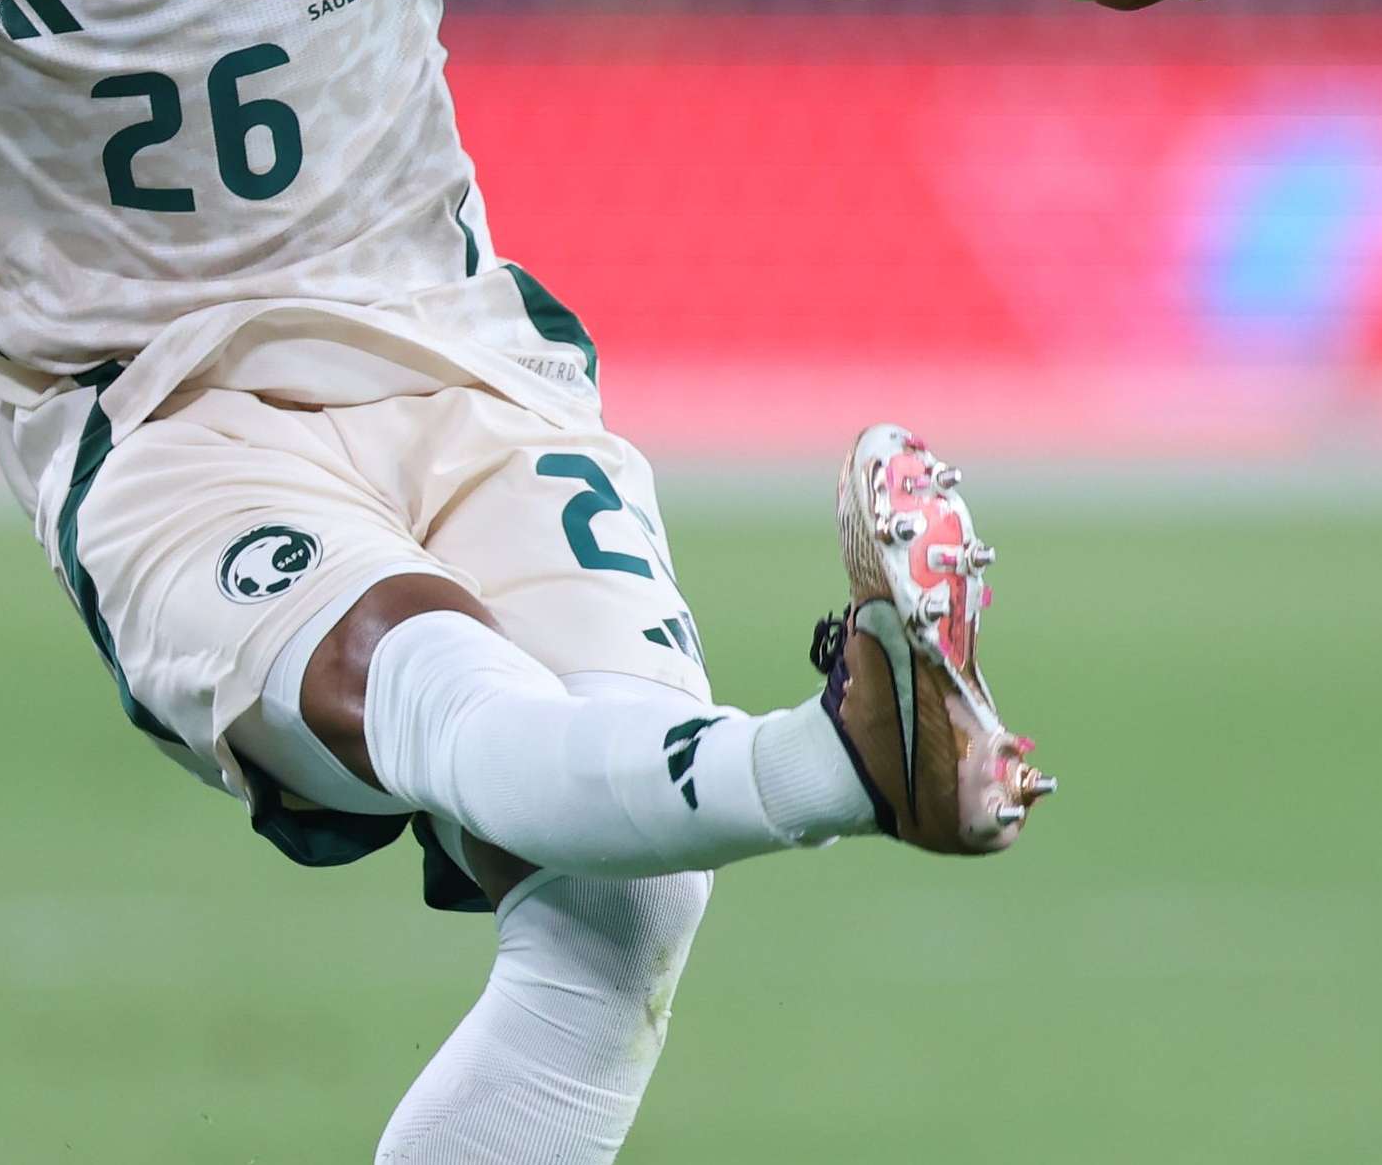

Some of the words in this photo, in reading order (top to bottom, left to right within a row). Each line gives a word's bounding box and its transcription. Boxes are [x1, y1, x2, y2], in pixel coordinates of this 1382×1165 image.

[91, 43, 303, 212] 26
[276, 548, 305, 570] SAFF
[536, 453, 657, 579] 2
